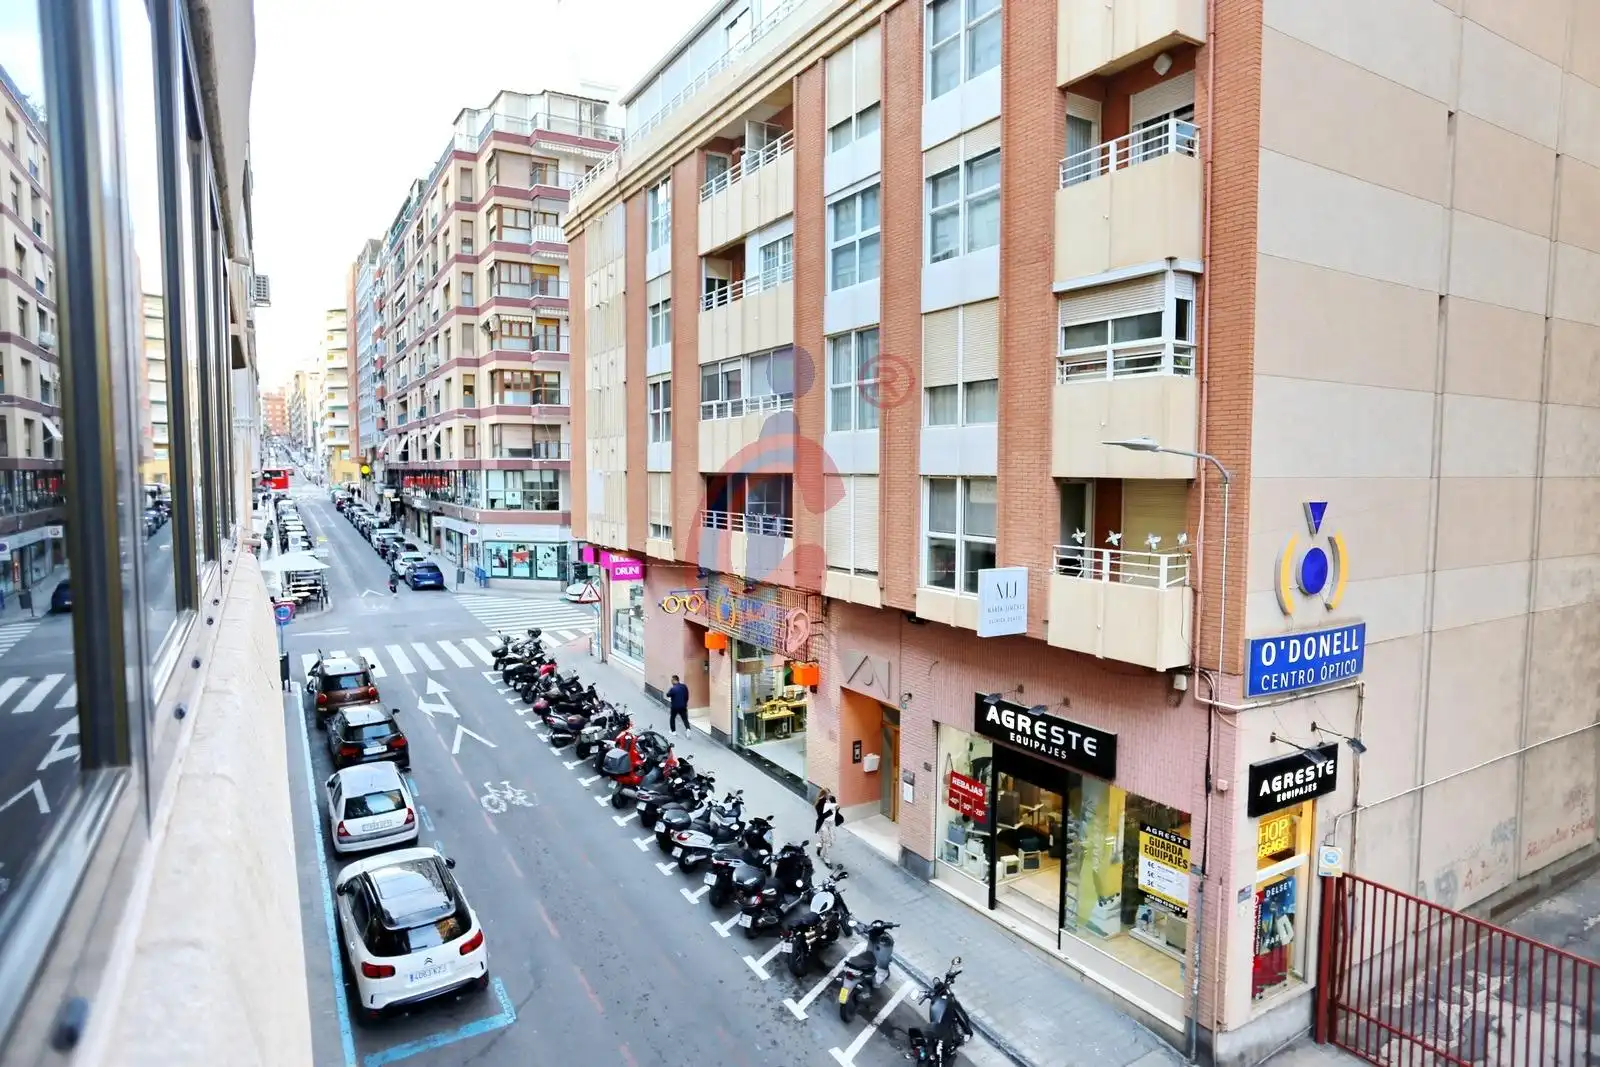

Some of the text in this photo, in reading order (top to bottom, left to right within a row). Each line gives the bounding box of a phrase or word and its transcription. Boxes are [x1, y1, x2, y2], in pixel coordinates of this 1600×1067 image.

[1261, 628, 1359, 667] O'DONELL
[1261, 658, 1357, 691] CENTRO ÓPTICO
[986, 705, 1097, 757] AGRESTE
[1009, 732, 1067, 760] EQUIPAJES
[952, 777, 983, 796] REBAJAS
[1259, 760, 1335, 797] AGRESTE
[1276, 782, 1317, 803] EQUIPAJES
[1145, 825, 1189, 847] AGRESTE
[1258, 818, 1289, 845] HOP
[1144, 844, 1188, 869] EQUIPAJES
[1149, 837, 1183, 856] GUARDA
[1265, 880, 1293, 898] DELSEY
